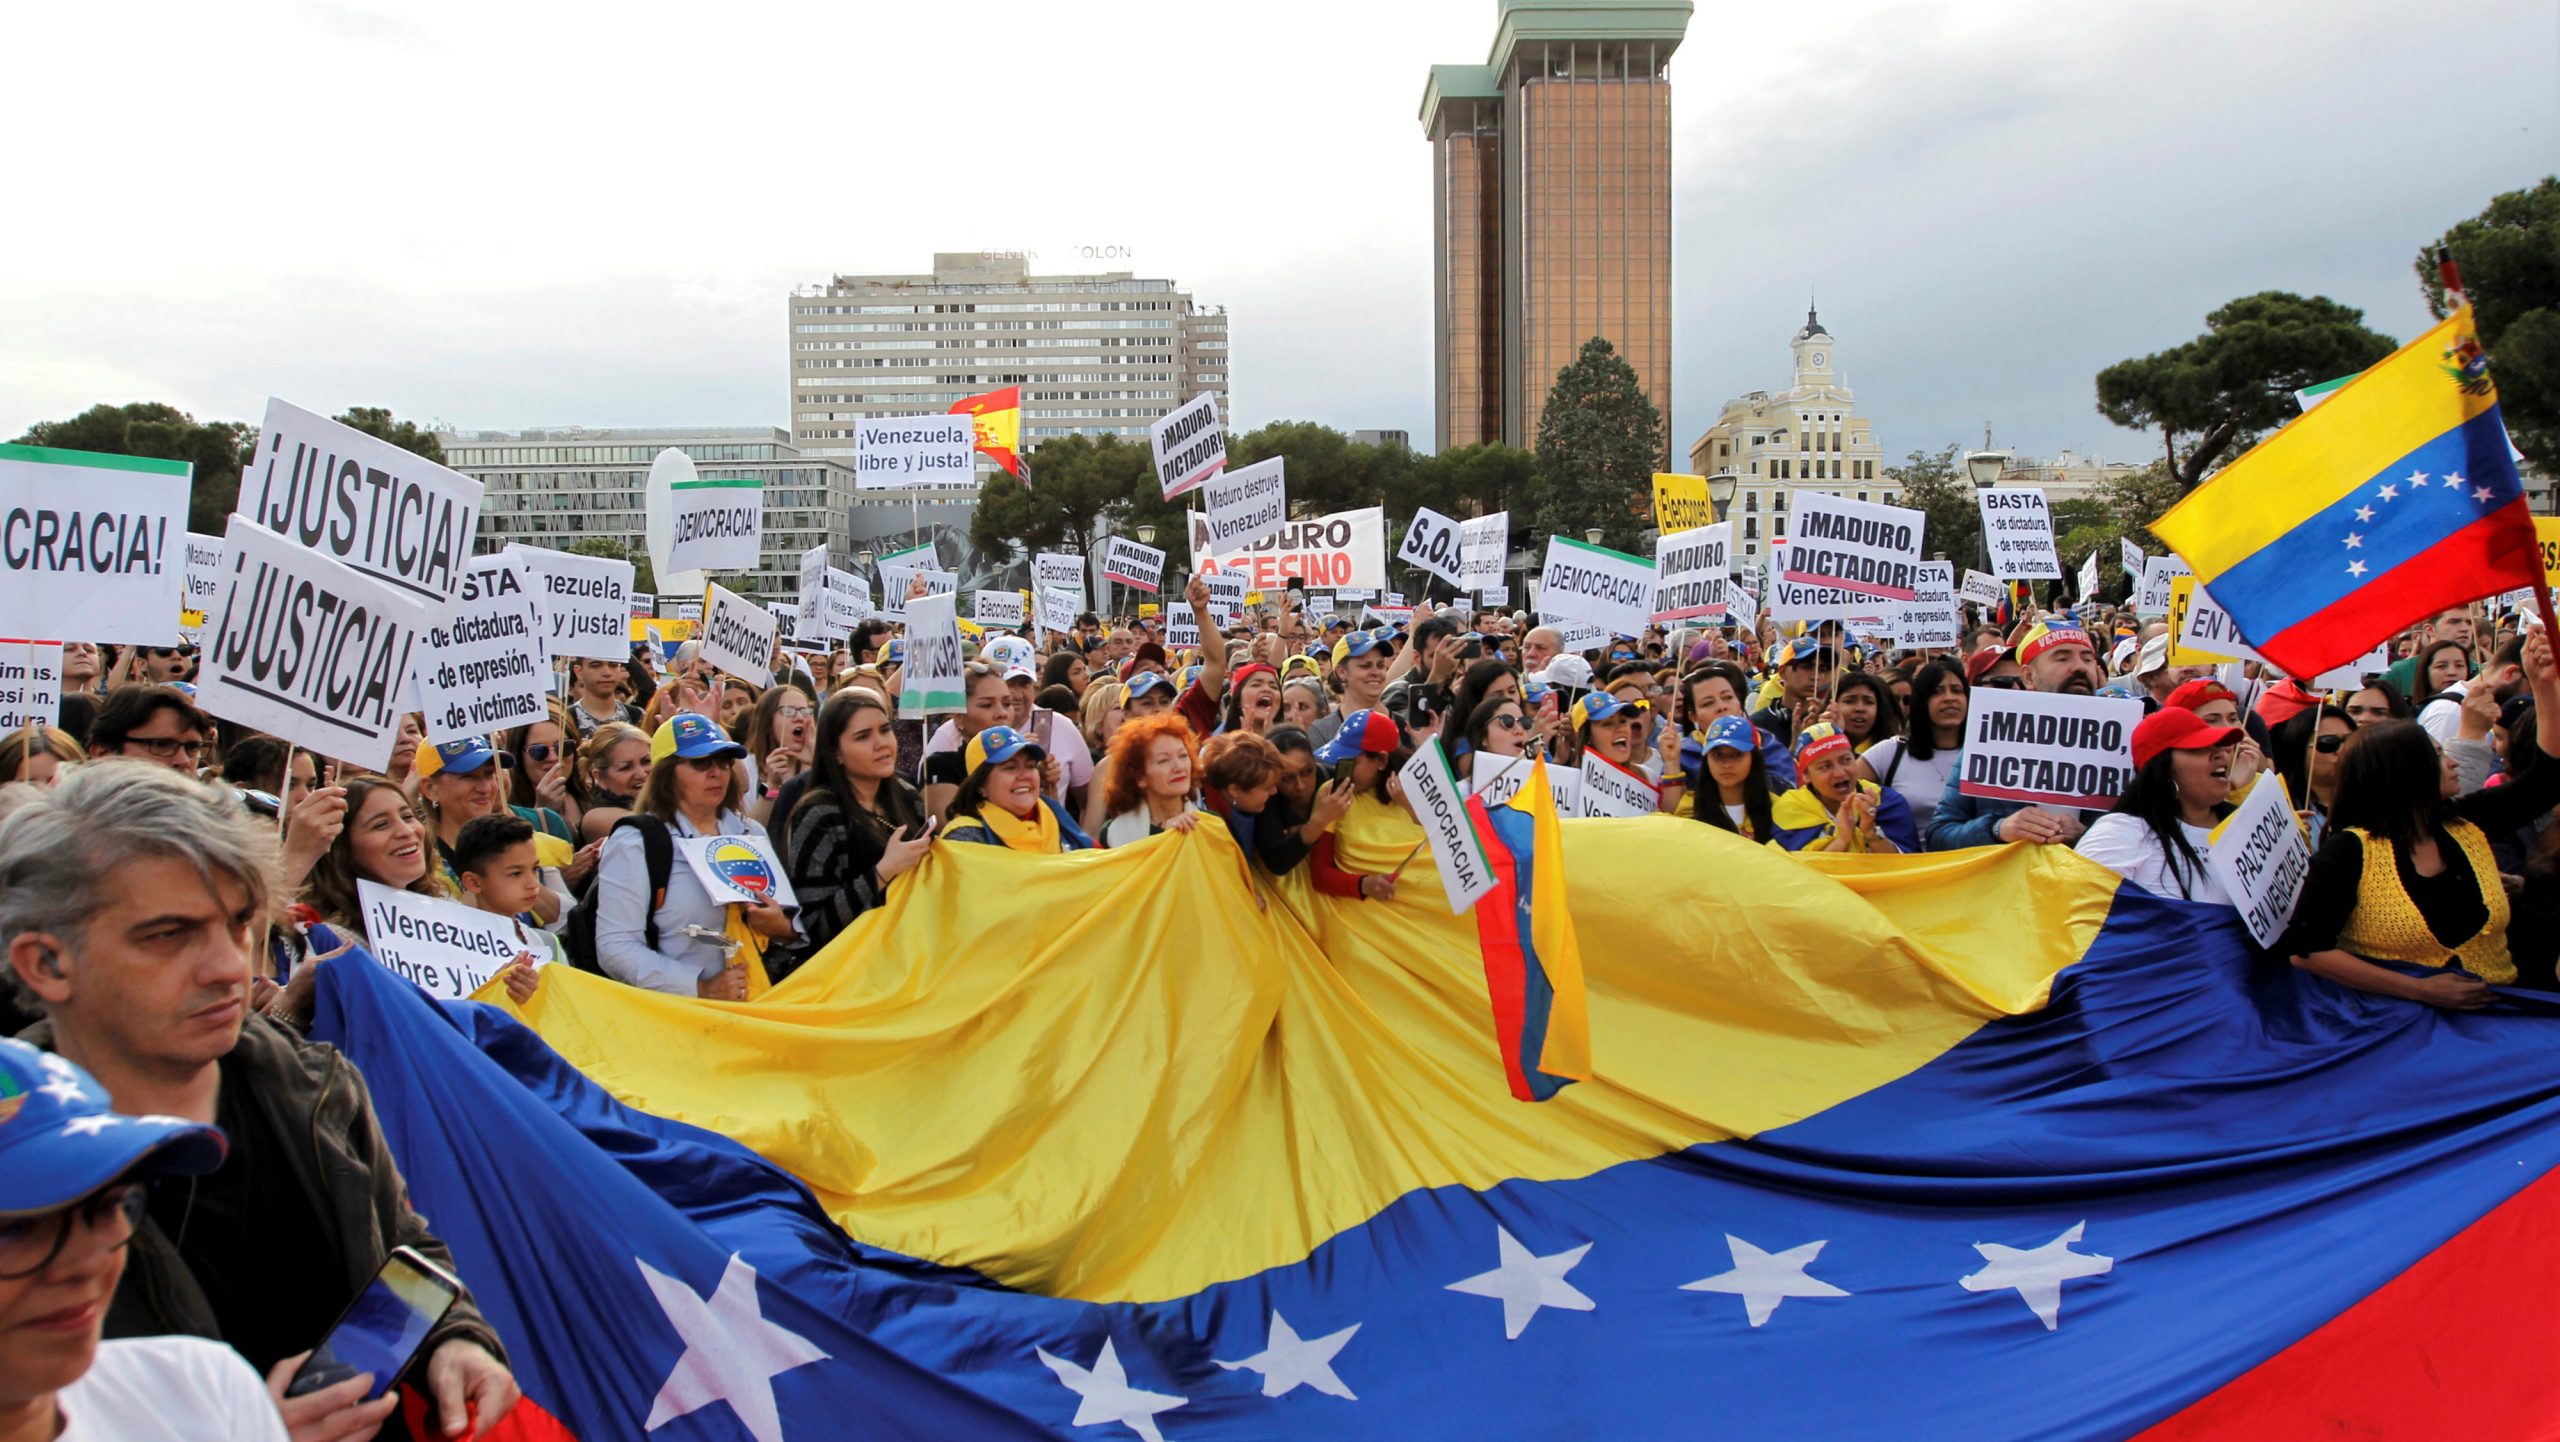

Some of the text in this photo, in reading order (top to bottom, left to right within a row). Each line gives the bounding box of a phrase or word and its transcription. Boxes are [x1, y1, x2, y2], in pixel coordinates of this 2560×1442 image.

[859, 425, 969, 450] ¡Venezuela,
[1161, 403, 1216, 455] ¡MADURO,
[859, 451, 969, 473] libre y justa!
[1162, 431, 1224, 485] DICTADOR!
[258, 433, 469, 594] ¡JUSTICIA!
[1207, 474, 1280, 517] ¡Maduro destruye
[1987, 494, 2044, 509] BASTA
[672, 507, 757, 552] ¡DEMOCRACIA!
[1211, 498, 1281, 541] Venezuela!
[1801, 511, 1916, 554] ¡MADURO,
[1996, 515, 2049, 533] de dictadura,
[1113, 543, 1160, 568] ¡MADURO,
[1661, 541, 1726, 579] ¡MADURO,
[2000, 536, 2053, 555] de represión,
[462, 567, 521, 600] STA
[1108, 560, 1160, 585] DICTADOR!
[1791, 546, 1918, 590] DICTADOR!
[1916, 568, 1949, 583] STA
[2004, 558, 2016, 573] de
[1206, 583, 1242, 599] ADURO,
[1543, 563, 1647, 608] ¡DEMOCRACIA!
[1655, 578, 1728, 612] DICTADOR!
[2144, 591, 2158, 607] EN
[452, 611, 529, 645] dictadura,
[552, 612, 564, 637] y
[568, 608, 625, 639] justa!
[703, 599, 774, 669] ¡Elecciones!
[1172, 612, 1226, 628] ¡MARO,
[1903, 609, 1914, 623] de
[1914, 608, 1952, 626] represión,
[2191, 607, 2224, 640] EN
[212, 551, 414, 729] ¡JUSTICIA!
[1905, 630, 1953, 643] de victimas.
[438, 647, 535, 690] de represión,
[446, 692, 541, 730] de victimas.
[1979, 711, 2127, 755] ¡MADURO,
[1586, 760, 1622, 800] Maduro
[1967, 753, 2134, 798] DICTADOR!
[1407, 757, 1479, 893] ¡DEMOCRACIA!
[2235, 800, 2289, 898] ¡PAZ SOCIAL
[2248, 832, 2312, 941] EN VENEZUELA!
[445, 966, 462, 996] y
